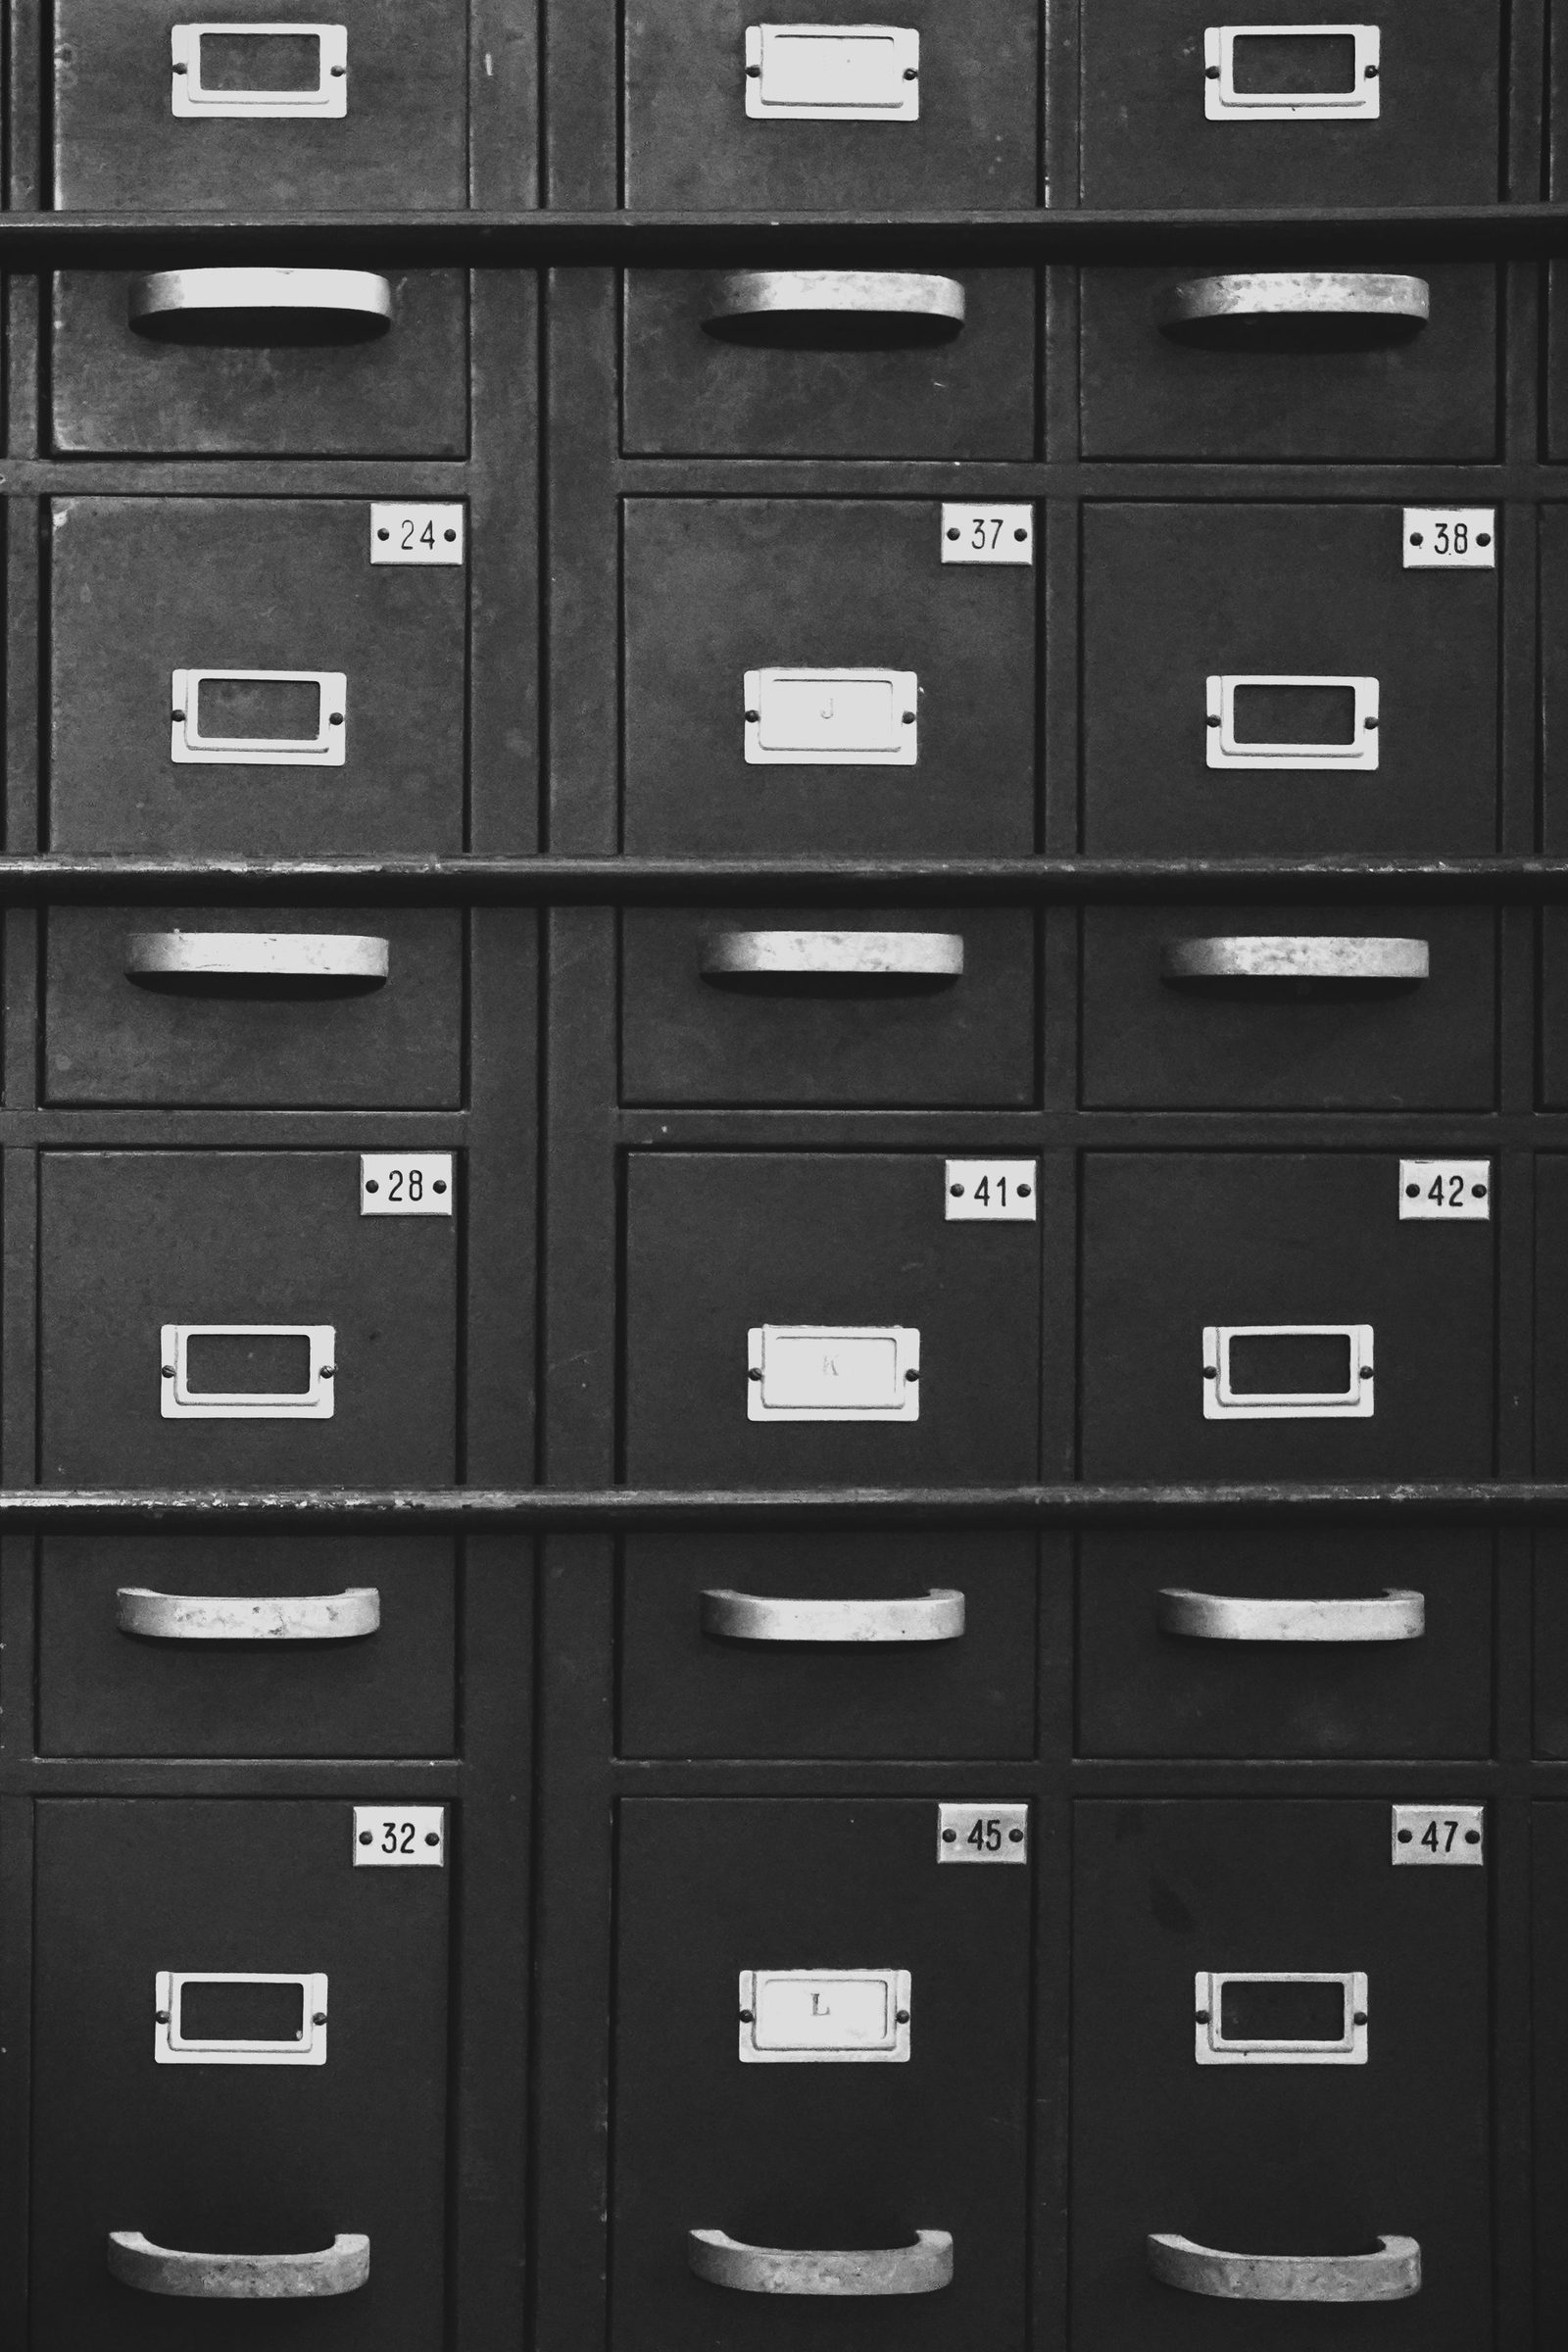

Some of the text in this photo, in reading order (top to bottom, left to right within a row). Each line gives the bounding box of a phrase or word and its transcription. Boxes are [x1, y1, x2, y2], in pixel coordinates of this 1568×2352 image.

[401, 519, 435, 550] 24
[971, 518, 1004, 550] 37
[1434, 522, 1468, 554] 38
[388, 1169, 422, 1201] 28
[973, 1175, 1006, 1207] 41
[1427, 1174, 1463, 1206] 42
[381, 1822, 416, 1854] 32
[966, 1819, 1003, 1851] 45
[1421, 1820, 1458, 1853] 47
[810, 1992, 830, 2017] L
